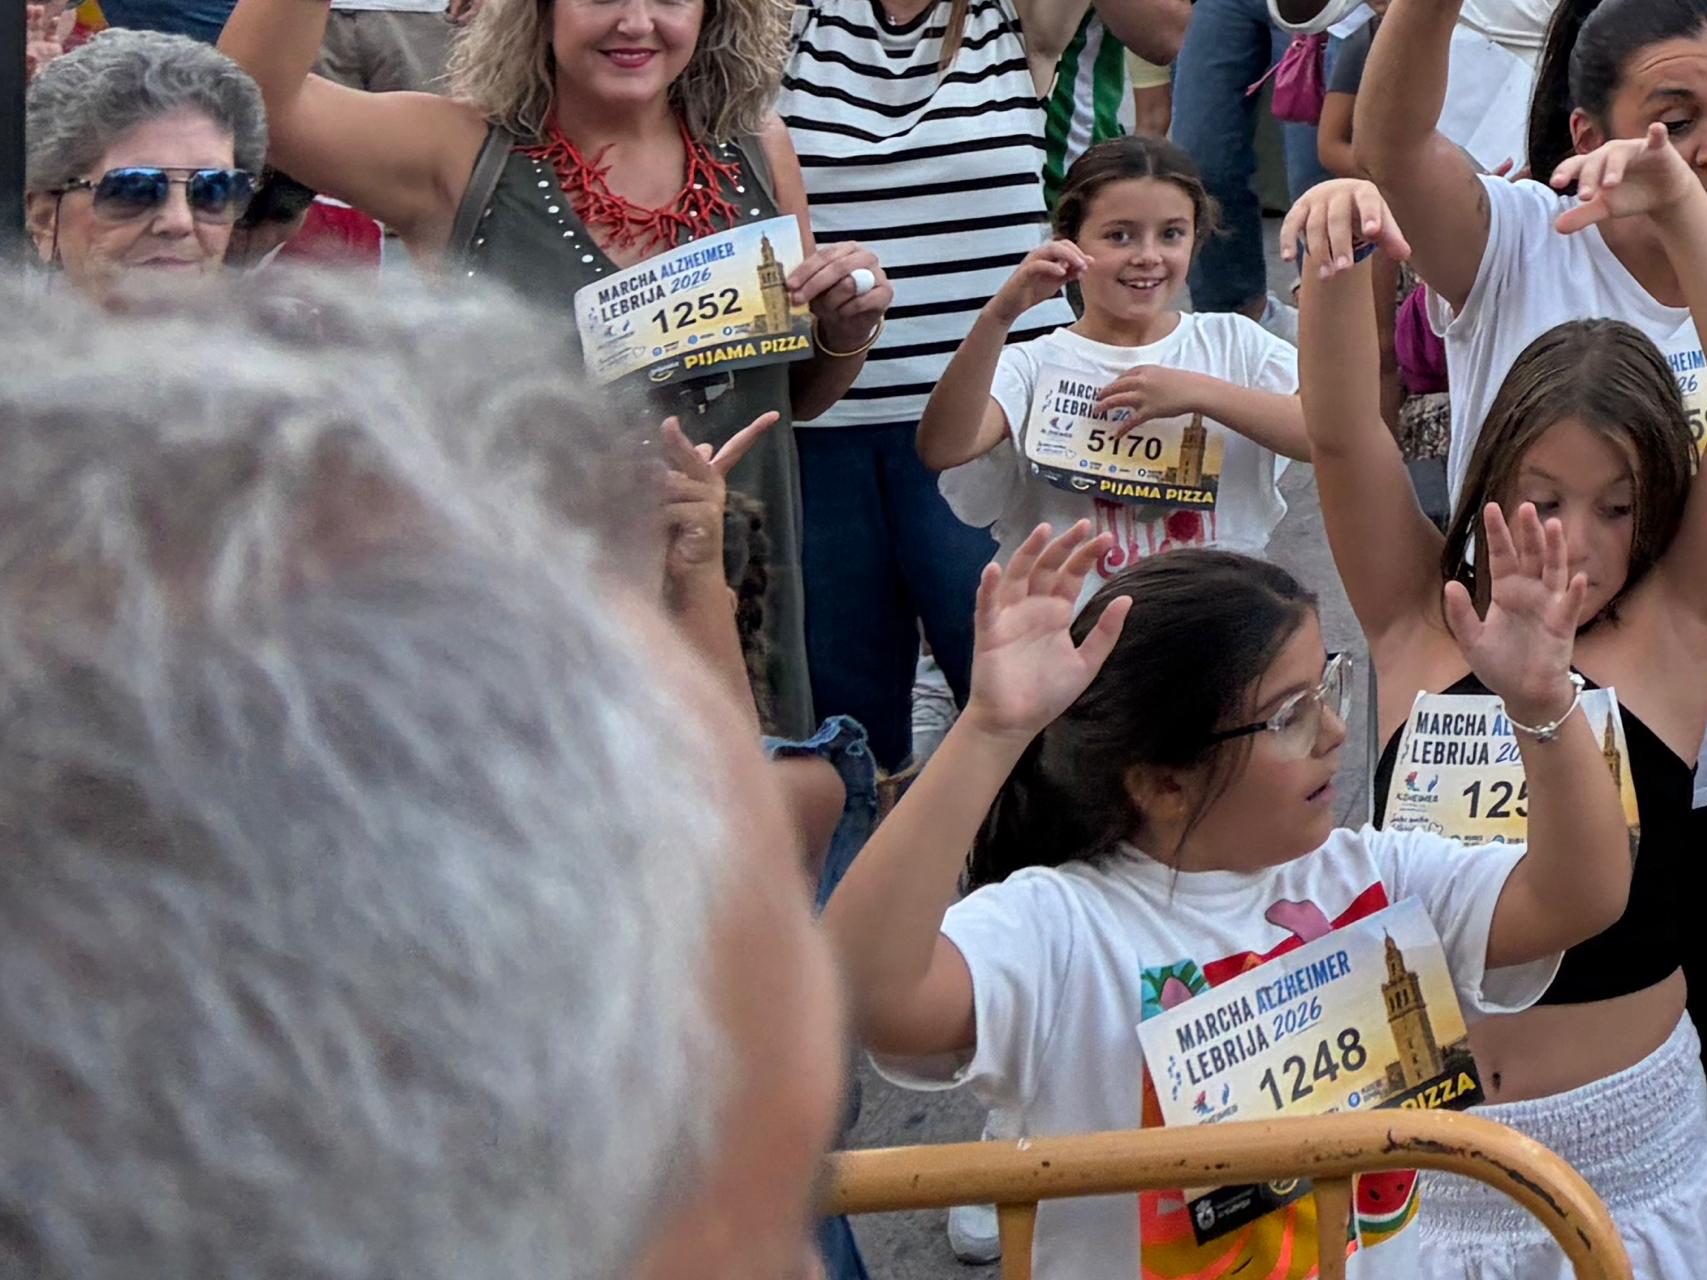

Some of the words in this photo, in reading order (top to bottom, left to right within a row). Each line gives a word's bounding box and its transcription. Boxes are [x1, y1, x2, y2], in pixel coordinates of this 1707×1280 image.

[595, 268, 659, 305] MARCHA
[659, 242, 736, 280] ALZHEIMER
[600, 287, 666, 323] LEBRIJA
[669, 266, 713, 295] 2026
[651, 287, 743, 334] 1252
[684, 343, 757, 370] PIJAMA
[760, 335, 811, 354] PIZZA
[1058, 380, 1102, 399] MARCH
[1086, 428, 1163, 460] 5170
[1100, 479, 1161, 501] PIJAMA
[1165, 487, 1215, 503] PIZZA
[1414, 711, 1488, 736] MARCHA
[1410, 742, 1490, 766] LEBRIJA
[1175, 997, 1254, 1053] MARCHA
[1254, 950, 1352, 1014] ALZHEIMER
[1182, 1031, 1270, 1088] LEBRIJA
[1272, 998, 1323, 1044] 2026
[1258, 1026, 1368, 1112] 1248
